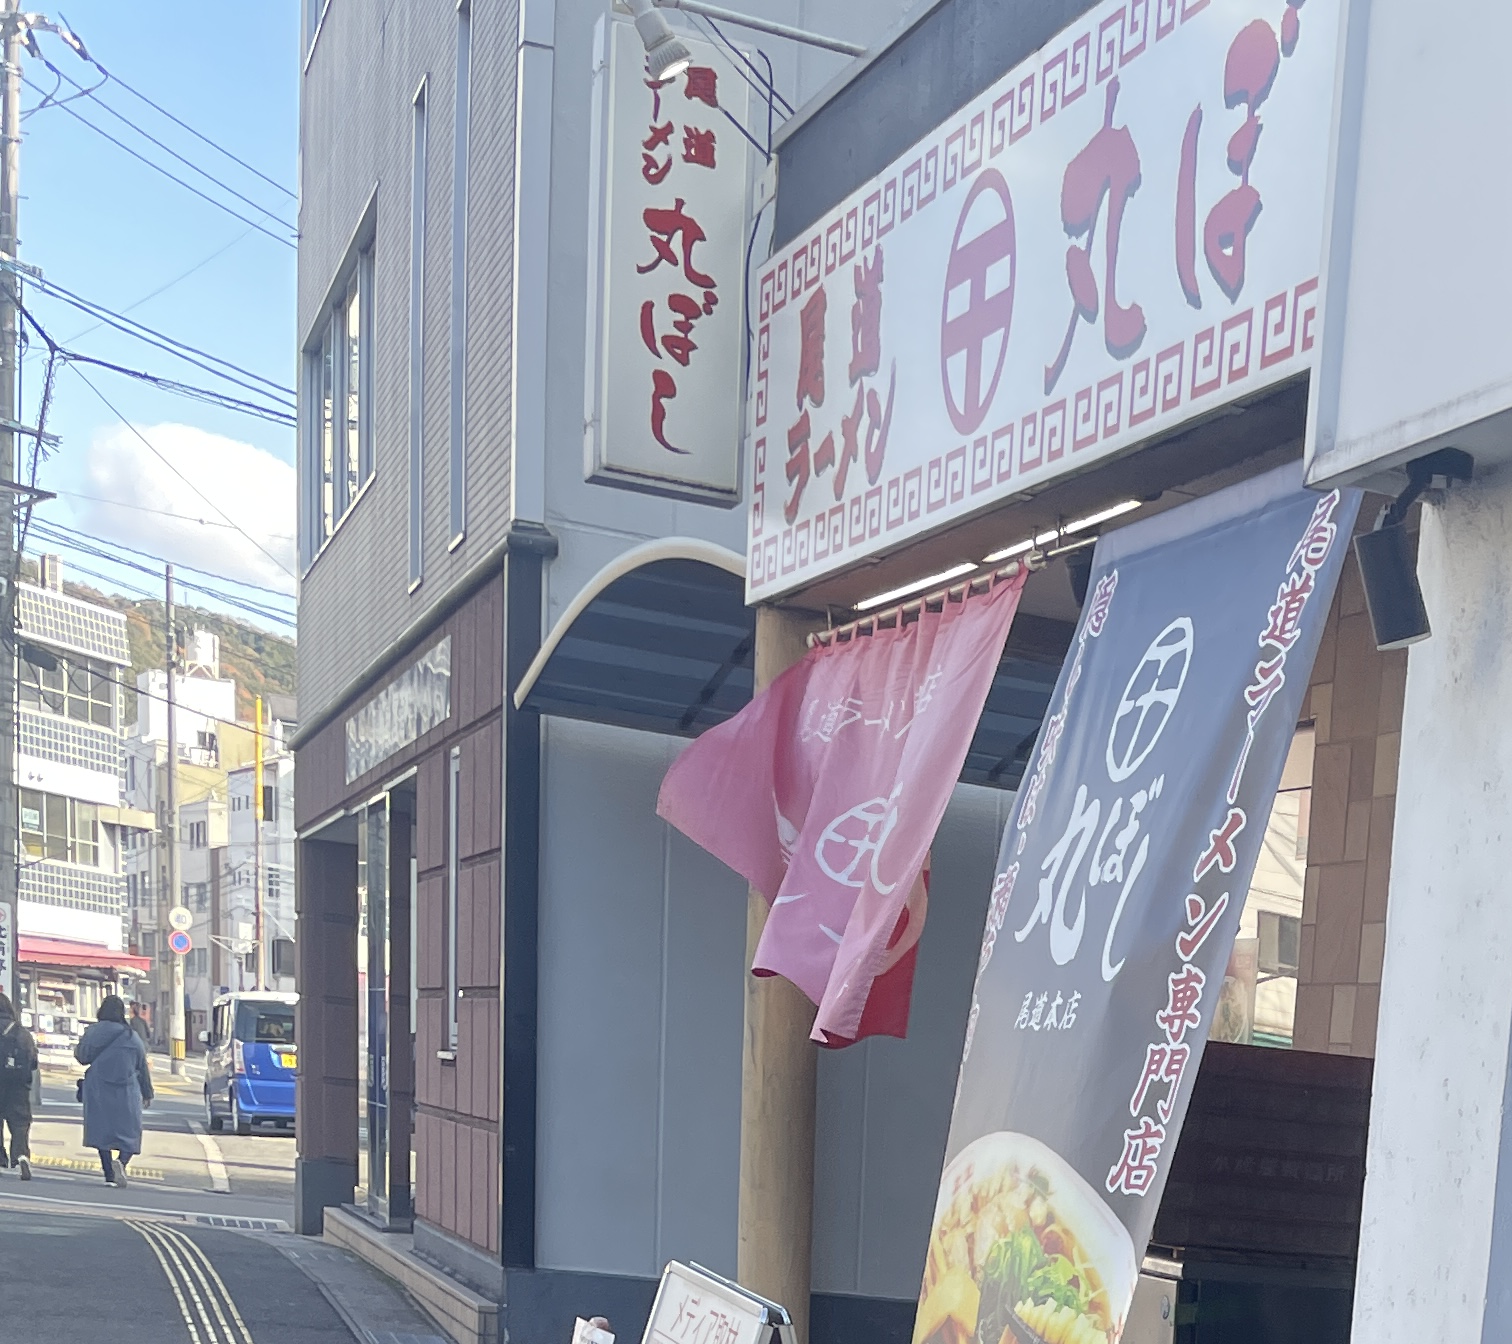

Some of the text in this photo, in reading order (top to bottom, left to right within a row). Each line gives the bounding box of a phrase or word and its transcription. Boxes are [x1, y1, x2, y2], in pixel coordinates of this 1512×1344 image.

[637, 198, 718, 454] 丸ぼし
[797, 244, 884, 411] 尾道
[784, 358, 896, 526] ラーメン
[1014, 772, 1166, 983] 丸ぼし
[1106, 485, 1341, 1197] 尾道ラーメン専門店
[1014, 989, 1082, 1032] 尾道本店
